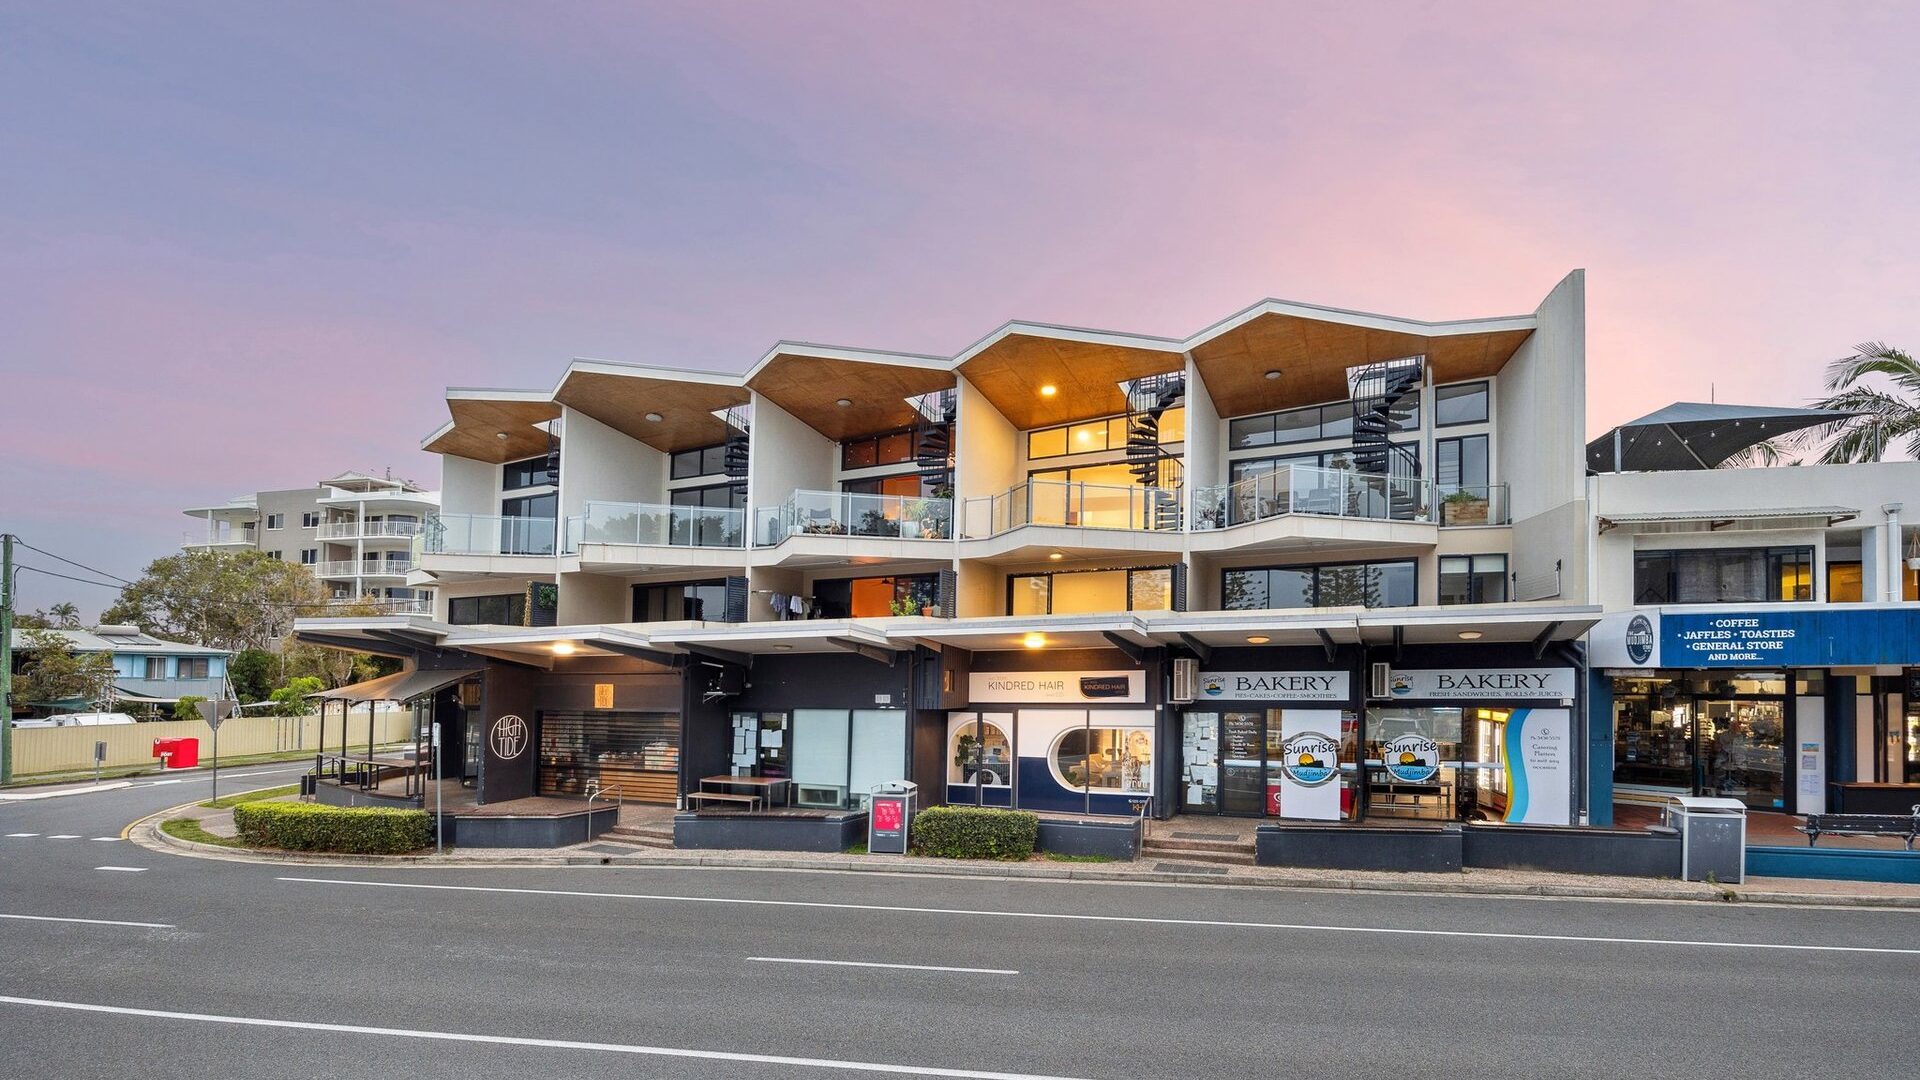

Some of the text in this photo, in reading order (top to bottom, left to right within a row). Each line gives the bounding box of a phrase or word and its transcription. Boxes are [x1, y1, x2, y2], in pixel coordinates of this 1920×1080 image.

[1716, 619, 1759, 627] COFFEE
[1684, 630, 1795, 639] JAFFLES TOASTIES
[1692, 641, 1783, 650] GENERAL STORE
[1203, 676, 1225, 684] Sunrise
[1236, 676, 1337, 690] BAKERY
[1437, 674, 1552, 689] BAKERY
[988, 681, 1064, 690] KINDRED HAIR
[497, 716, 522, 737] HIGH
[498, 736, 520, 757] TIDE
[1284, 742, 1334, 755] Sunrise
[1384, 740, 1437, 754] Sunrise
[1293, 770, 1329, 778] Mudjimba
[1393, 769, 1431, 778] Mudjimba
